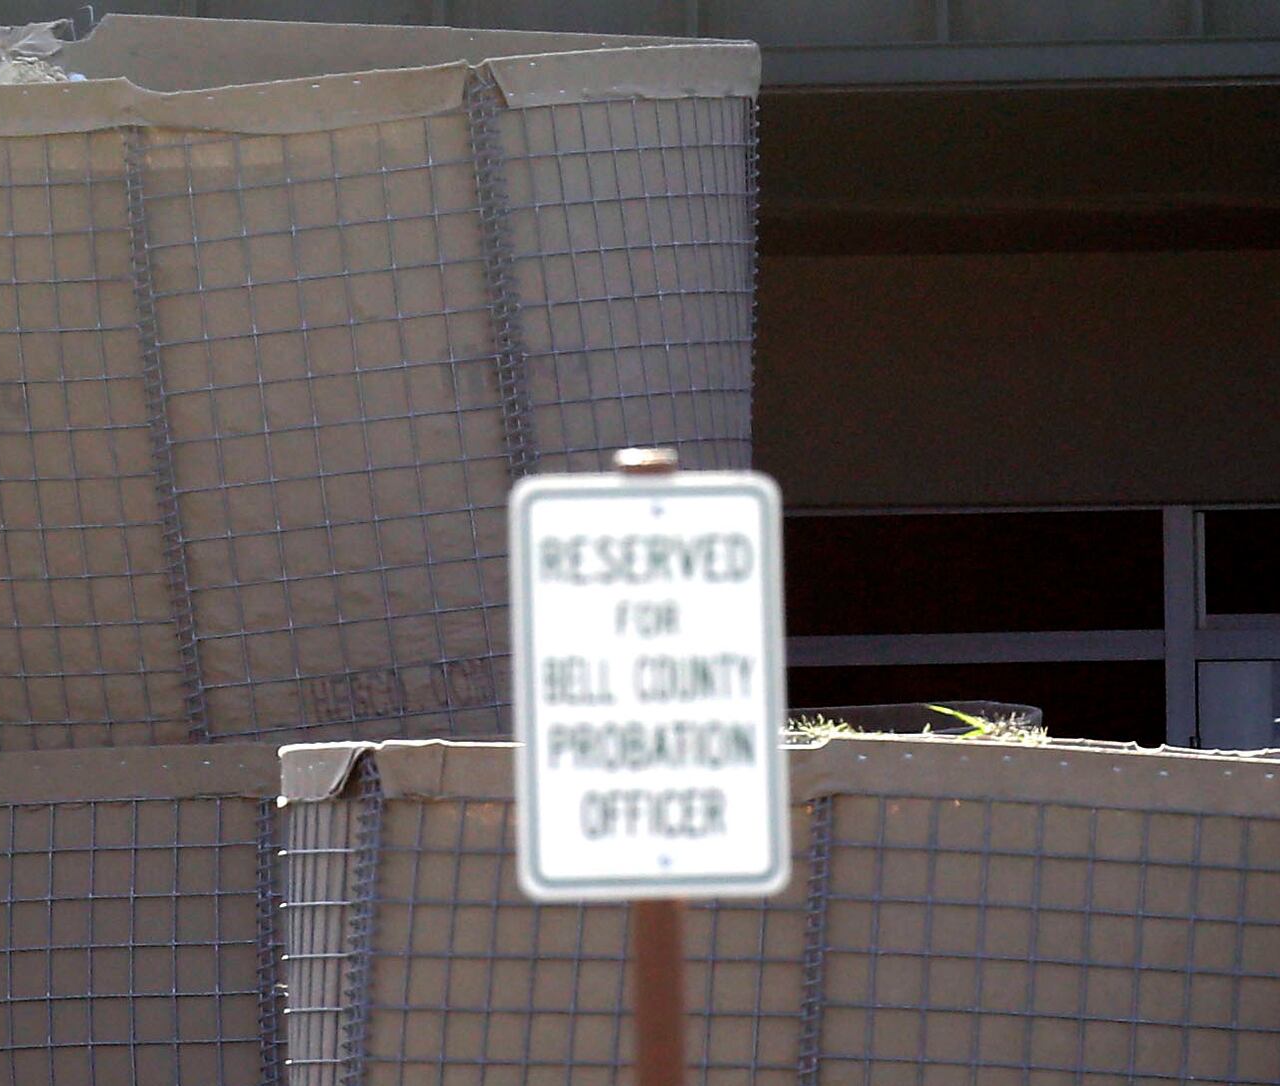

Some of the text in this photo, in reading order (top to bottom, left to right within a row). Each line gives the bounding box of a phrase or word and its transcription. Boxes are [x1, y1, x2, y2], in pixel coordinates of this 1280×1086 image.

[539, 532, 756, 586] RESERVED
[616, 600, 681, 637] FOR
[542, 651, 754, 705] BELL COUNTY
[546, 719, 757, 772] PROBATION
[579, 787, 727, 841] OFFICER
